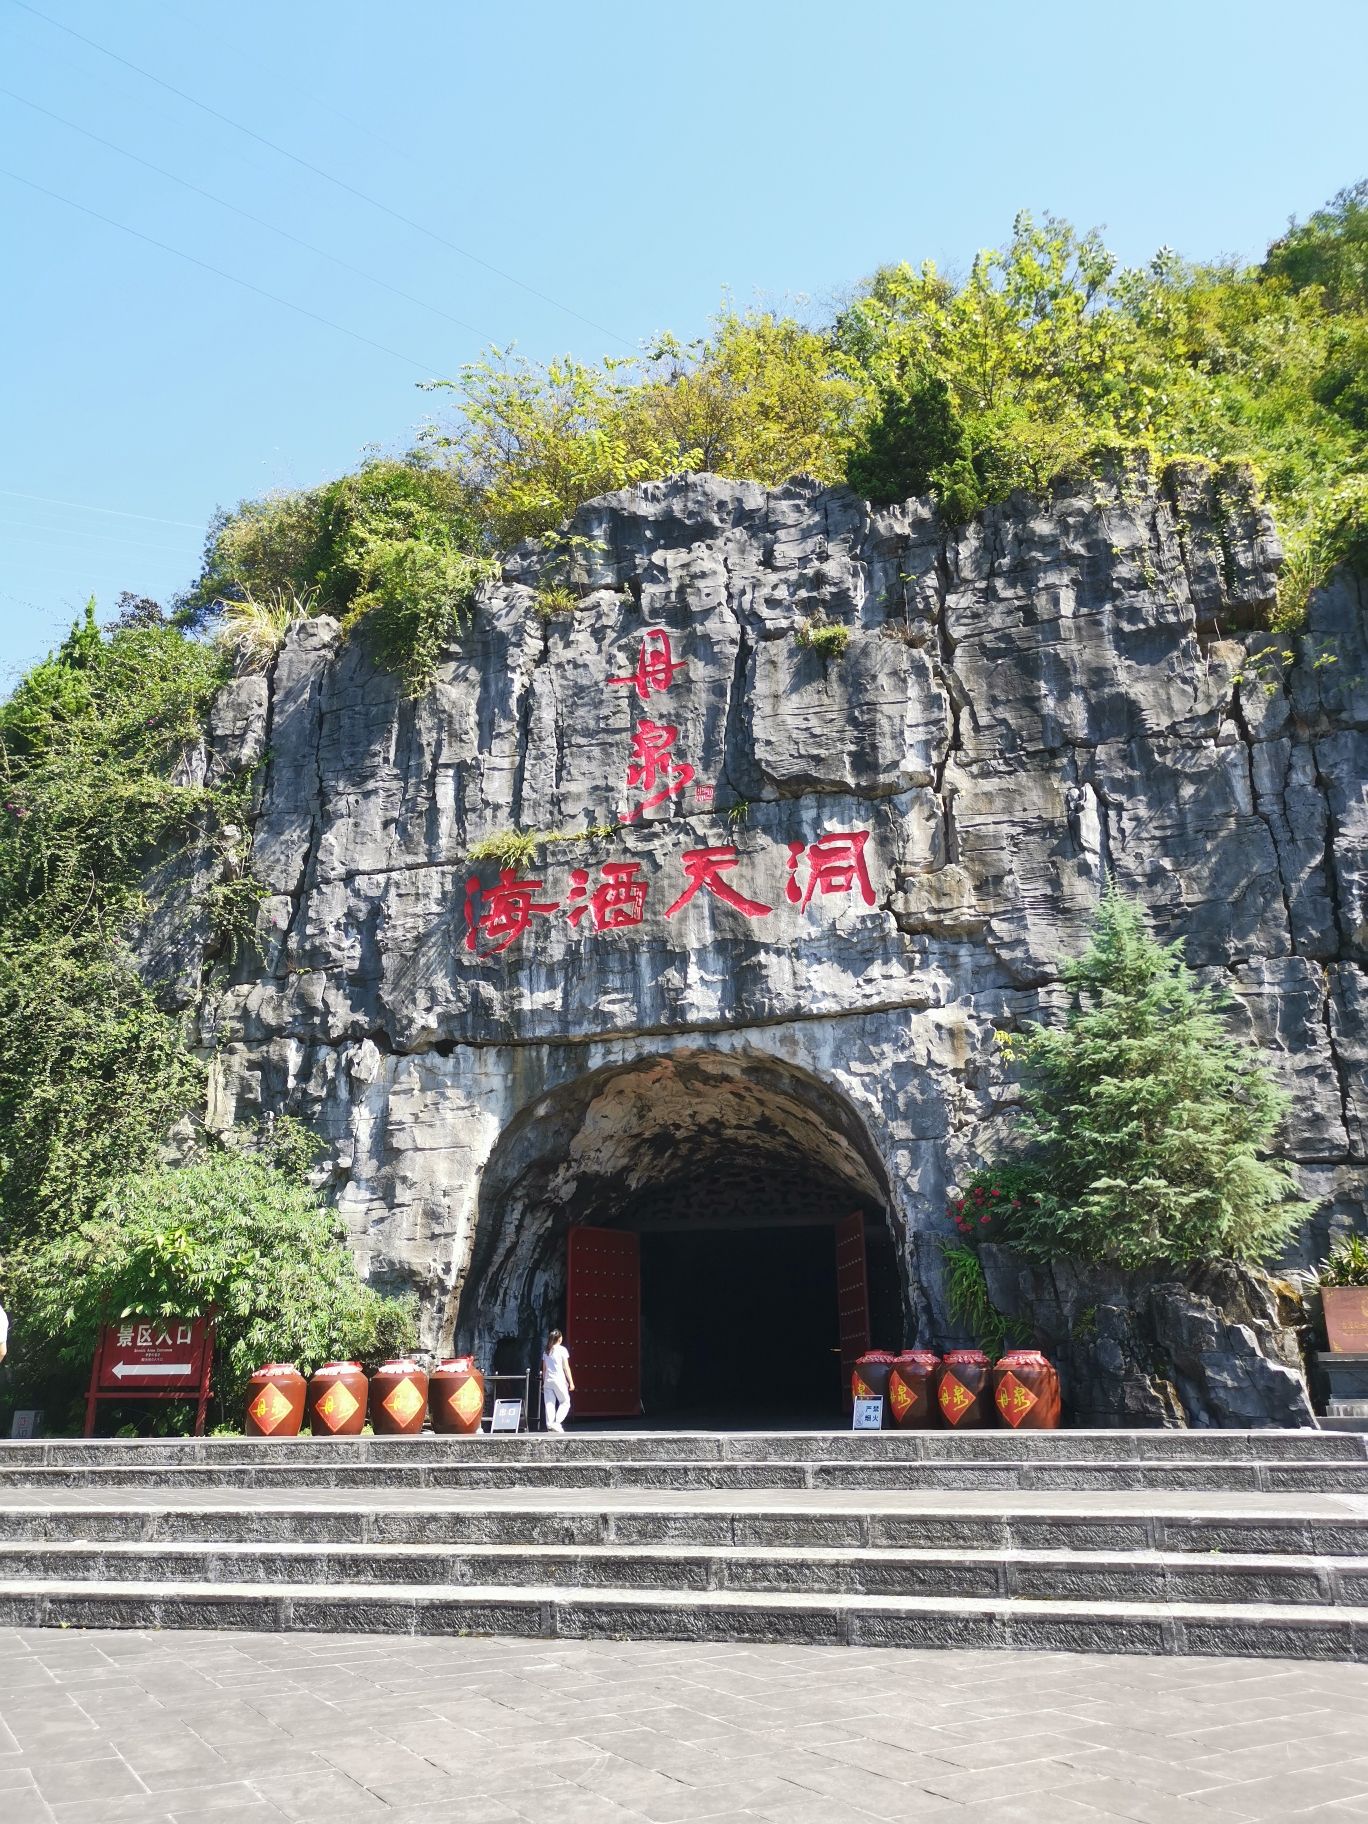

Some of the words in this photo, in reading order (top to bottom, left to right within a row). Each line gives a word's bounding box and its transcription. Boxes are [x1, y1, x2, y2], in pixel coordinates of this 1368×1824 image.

[606, 628, 695, 823] 丹泉
[117, 1325, 192, 1347] 景区入口
[939, 1385, 969, 1411] 丹泉
[997, 1385, 1031, 1413] 丹泉
[864, 1414, 879, 1422] 烟火
